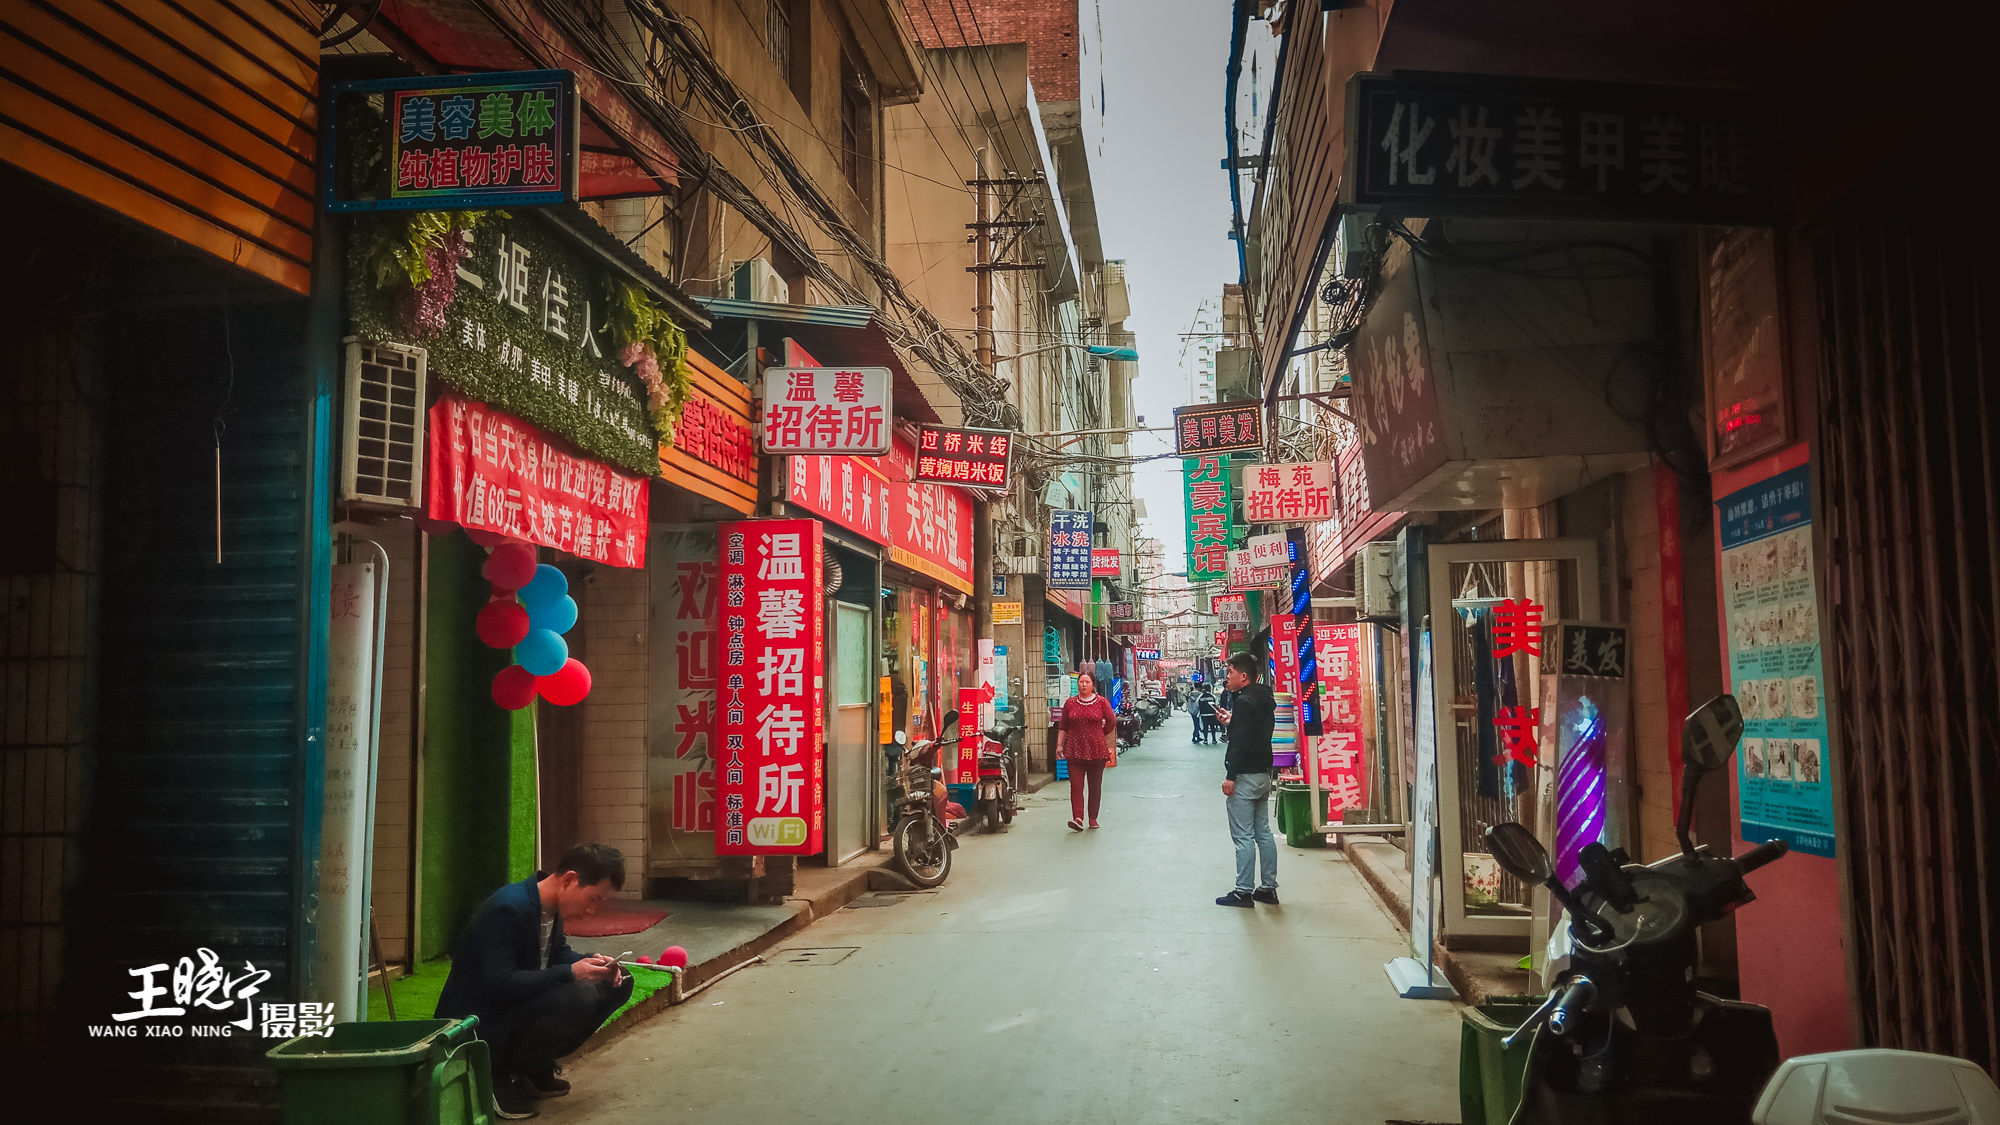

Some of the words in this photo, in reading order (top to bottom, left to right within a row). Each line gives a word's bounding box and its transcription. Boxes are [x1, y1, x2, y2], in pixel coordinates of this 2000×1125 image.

[400, 91, 555, 144] 美容美体
[398, 143, 554, 189] 纯植物护肤
[1381, 101, 1750, 196] 化妆美甲美睫
[530, 357, 551, 392] 美甲
[786, 371, 865, 403] 温馨
[671, 393, 751, 482] 馨招待所
[766, 403, 884, 450] 招待所
[921, 430, 1007, 456] 过桥米线
[1183, 412, 1255, 449] 美甲美发
[918, 456, 1005, 483] 黄焖鸡米饭
[1259, 465, 1315, 489] 梅苑
[793, 455, 890, 541] 黄焖鸡米饭
[906, 459, 959, 568] 芙蓉兴盛
[1054, 513, 1089, 529] 干洗
[1189, 455, 1229, 573] 万豪宾馆
[1248, 487, 1330, 520] 招待所
[728, 533, 744, 565] 空调
[1053, 531, 1090, 547] 水洗
[1092, 556, 1119, 568] 货批发
[1253, 541, 1286, 559] 便利
[728, 574, 744, 607] 淋浴
[1233, 566, 1283, 586] 招待所
[728, 616, 744, 666] 钟点房
[1565, 627, 1623, 676] 美发
[756, 532, 805, 814] 温馨招待所
[728, 674, 744, 725] 单人间
[727, 734, 744, 785] 双人间
[960, 701, 975, 783] 生活用品
[726, 794, 744, 846] 标准间
